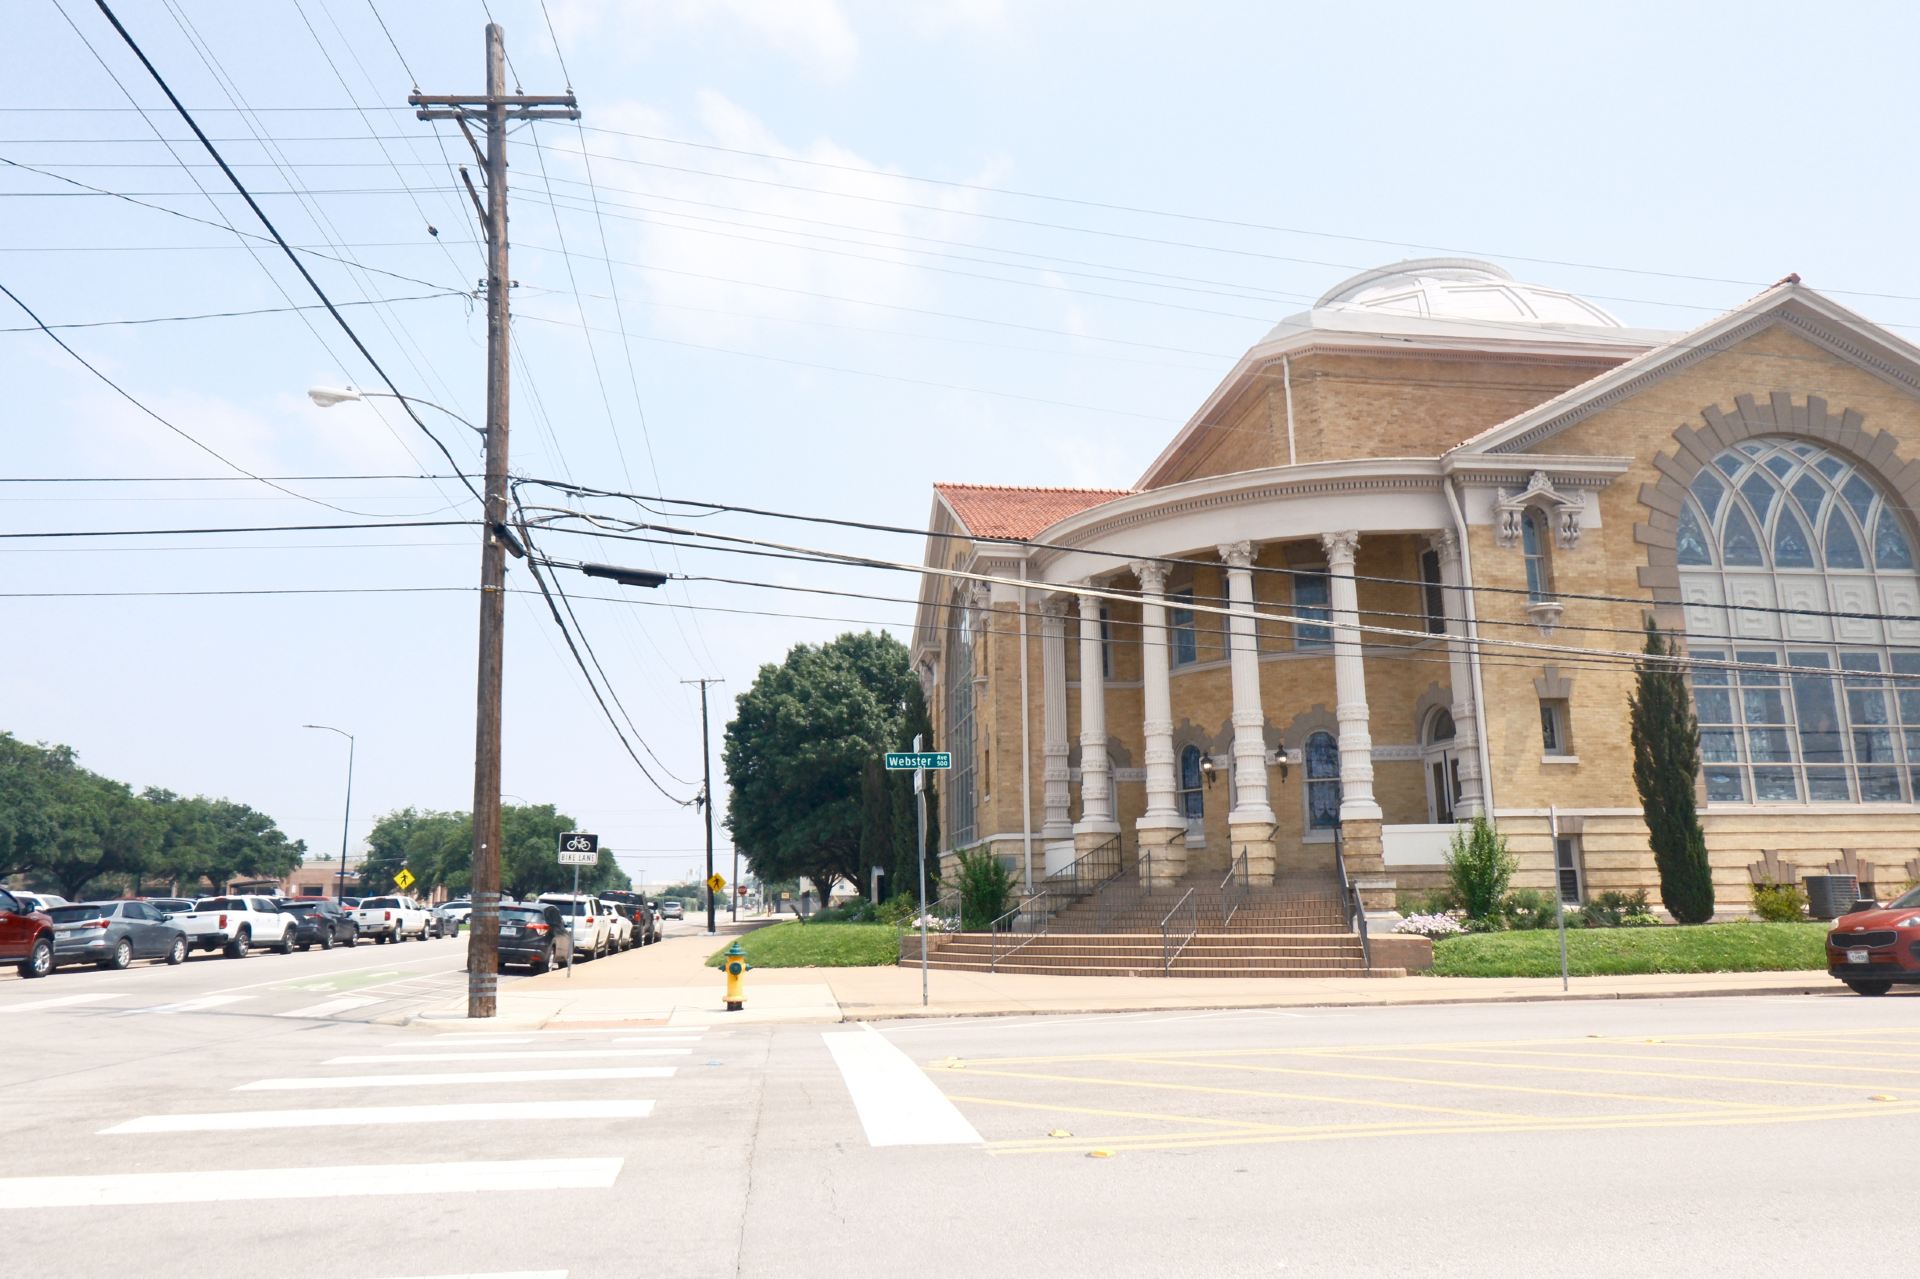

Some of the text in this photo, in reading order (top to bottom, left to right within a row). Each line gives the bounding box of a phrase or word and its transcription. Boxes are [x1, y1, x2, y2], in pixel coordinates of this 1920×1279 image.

[889, 756, 931, 767] Webster
[561, 853, 595, 862] BIKE LANE
